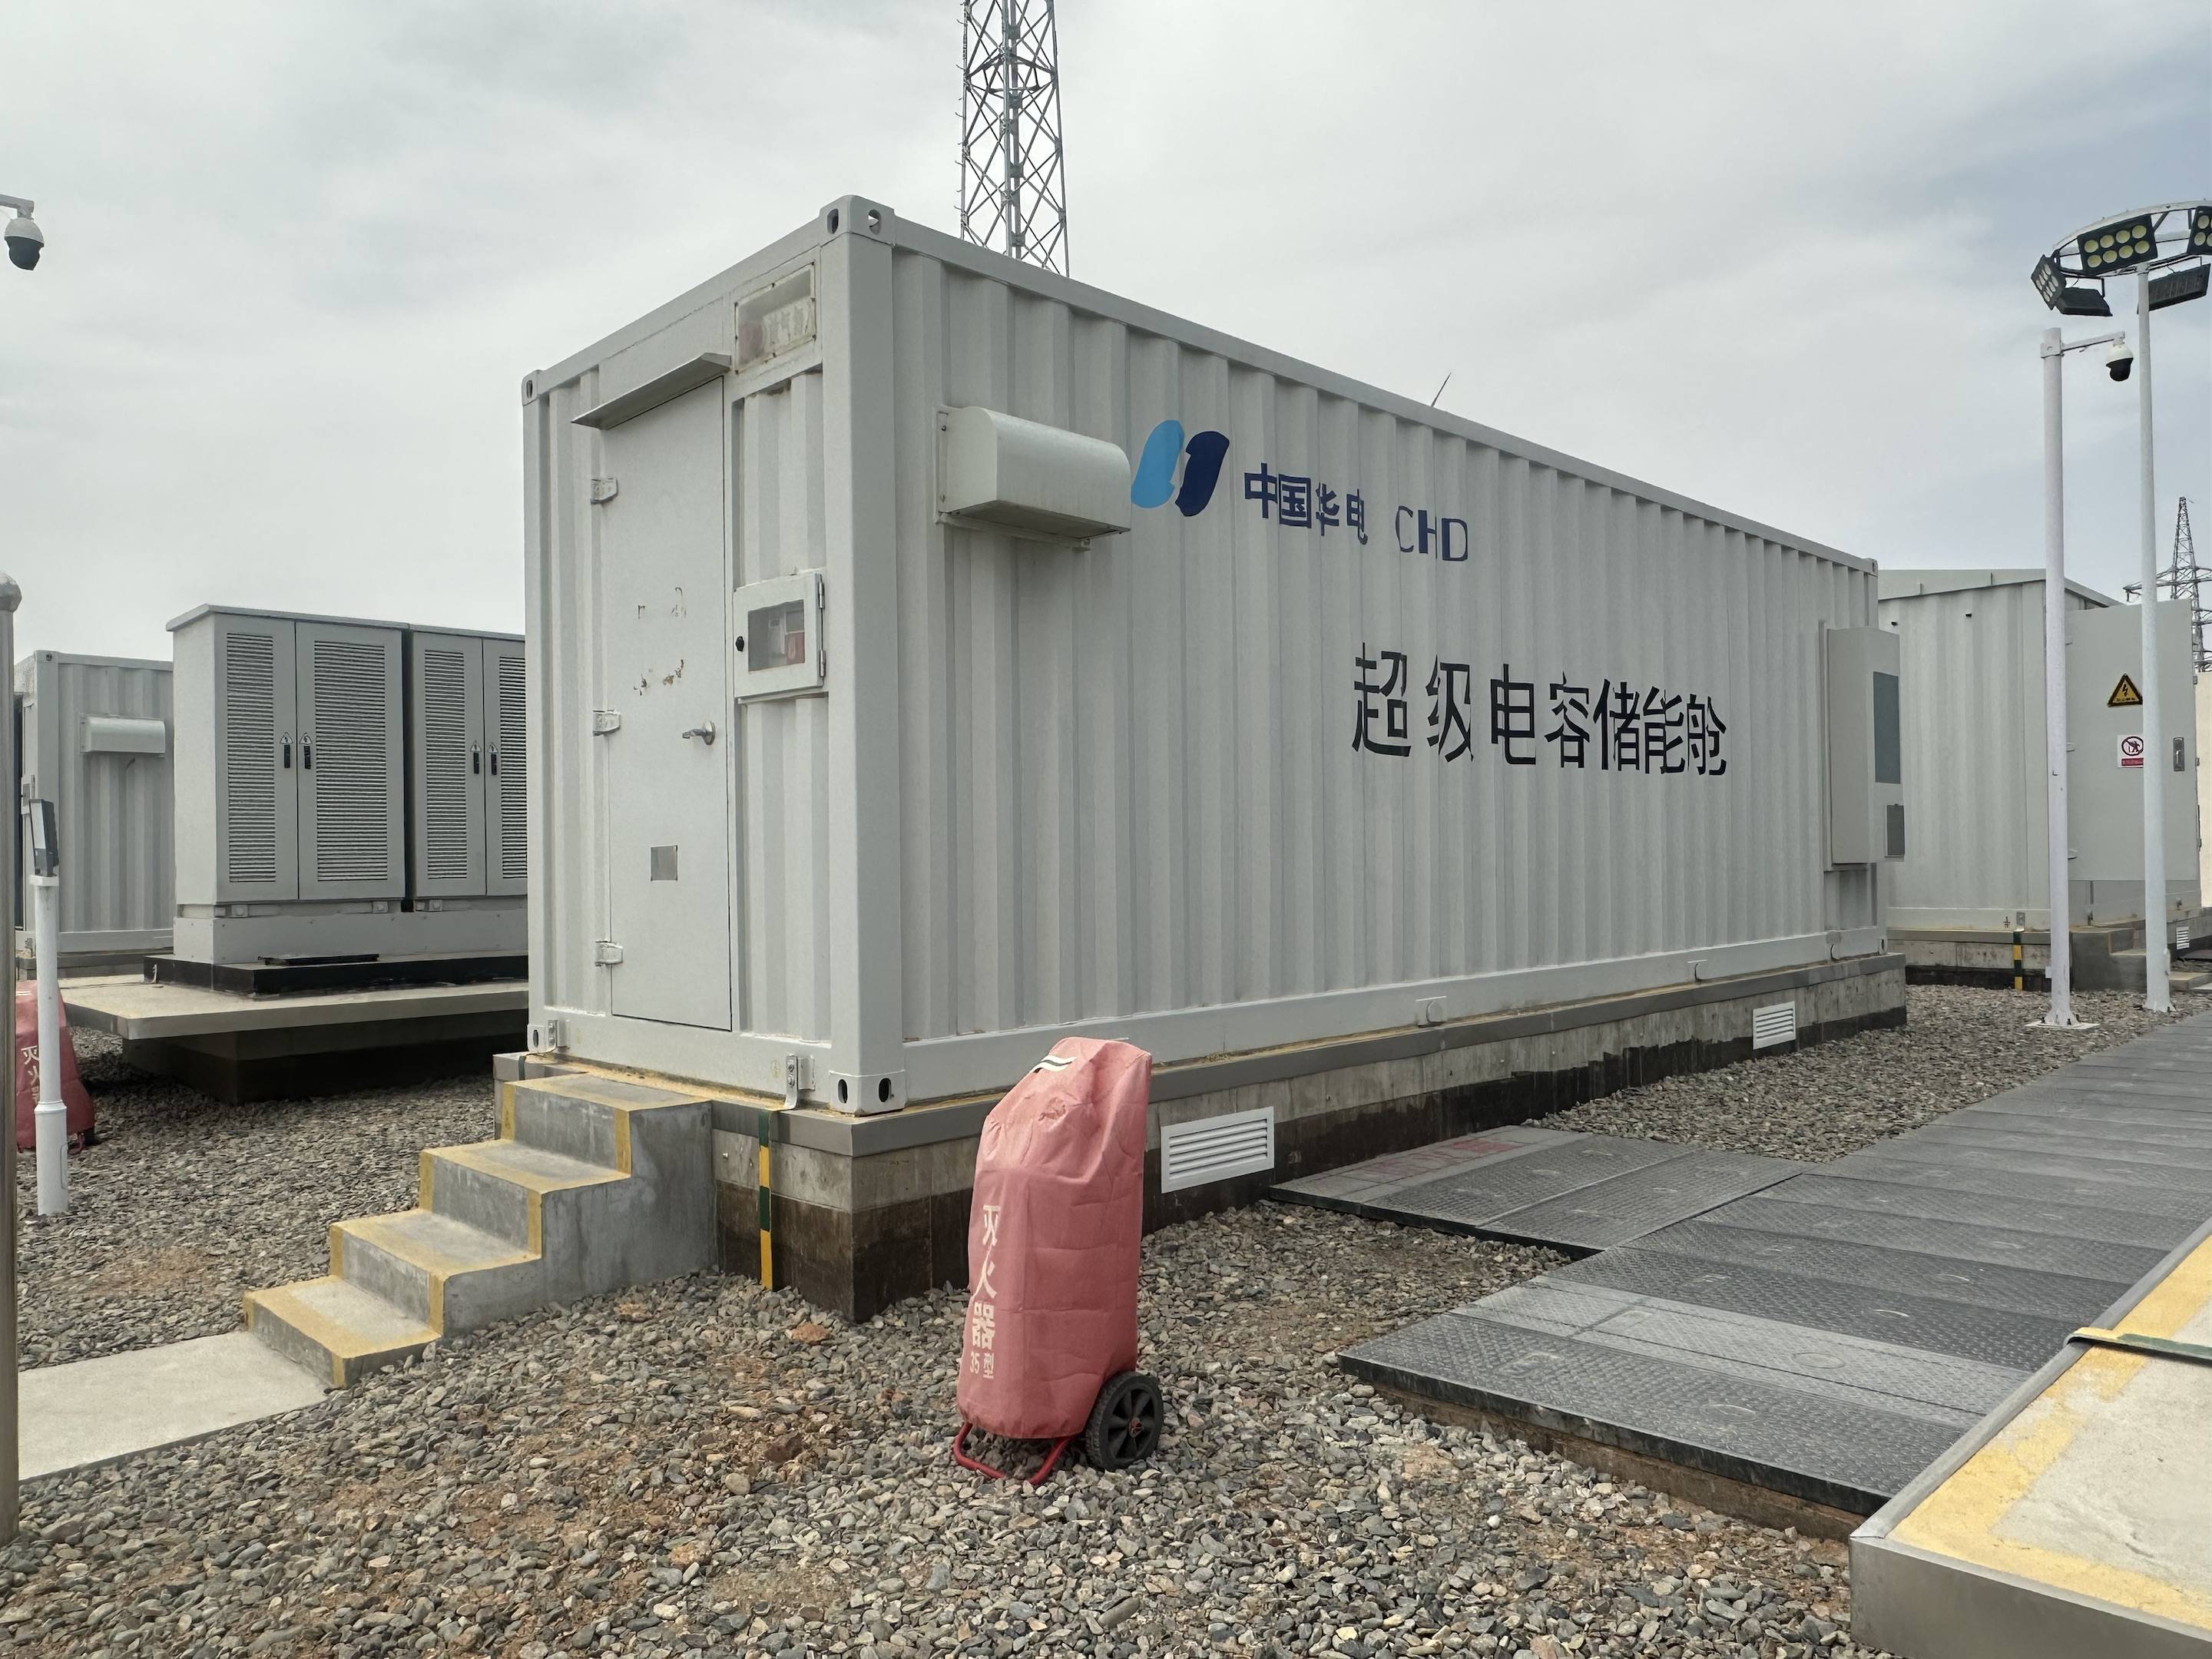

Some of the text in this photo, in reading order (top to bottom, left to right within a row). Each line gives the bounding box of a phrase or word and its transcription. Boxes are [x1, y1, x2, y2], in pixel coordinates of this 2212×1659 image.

[1244, 462, 1469, 561] 中国华电 CHD
[1351, 642, 1727, 776] 超级电容储能舱
[972, 1204, 1001, 1350] 灭火器
